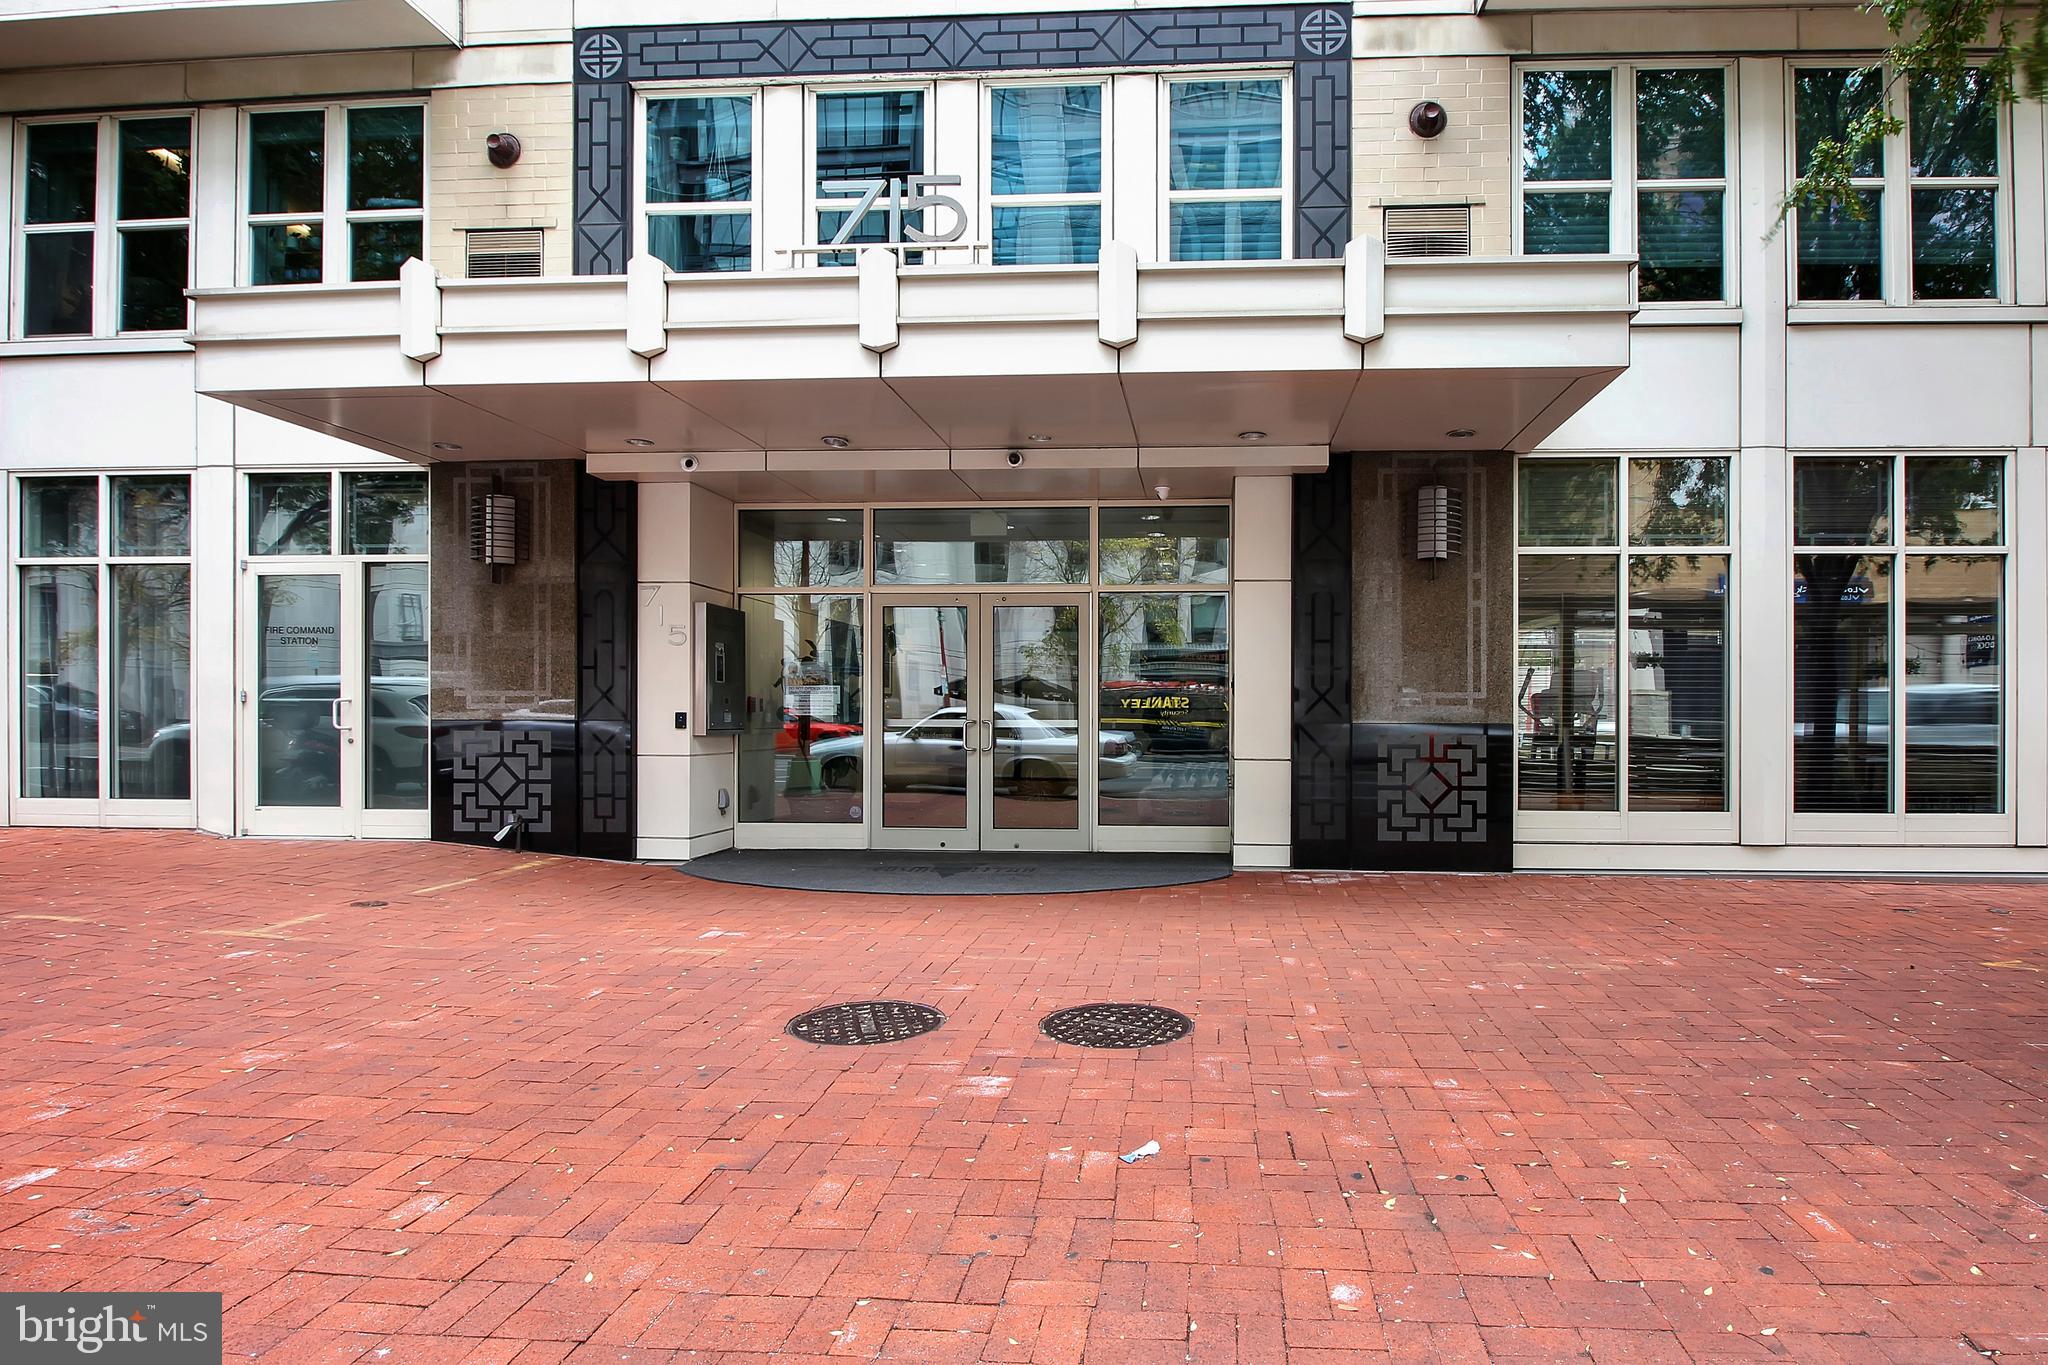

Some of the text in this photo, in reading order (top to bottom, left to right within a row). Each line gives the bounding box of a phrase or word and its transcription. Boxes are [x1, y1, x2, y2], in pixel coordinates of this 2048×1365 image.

[821, 174, 968, 245] 715
[264, 626, 335, 634] FIRE COMMAND
[638, 584, 687, 647] 715
[280, 636, 319, 645] STATION
